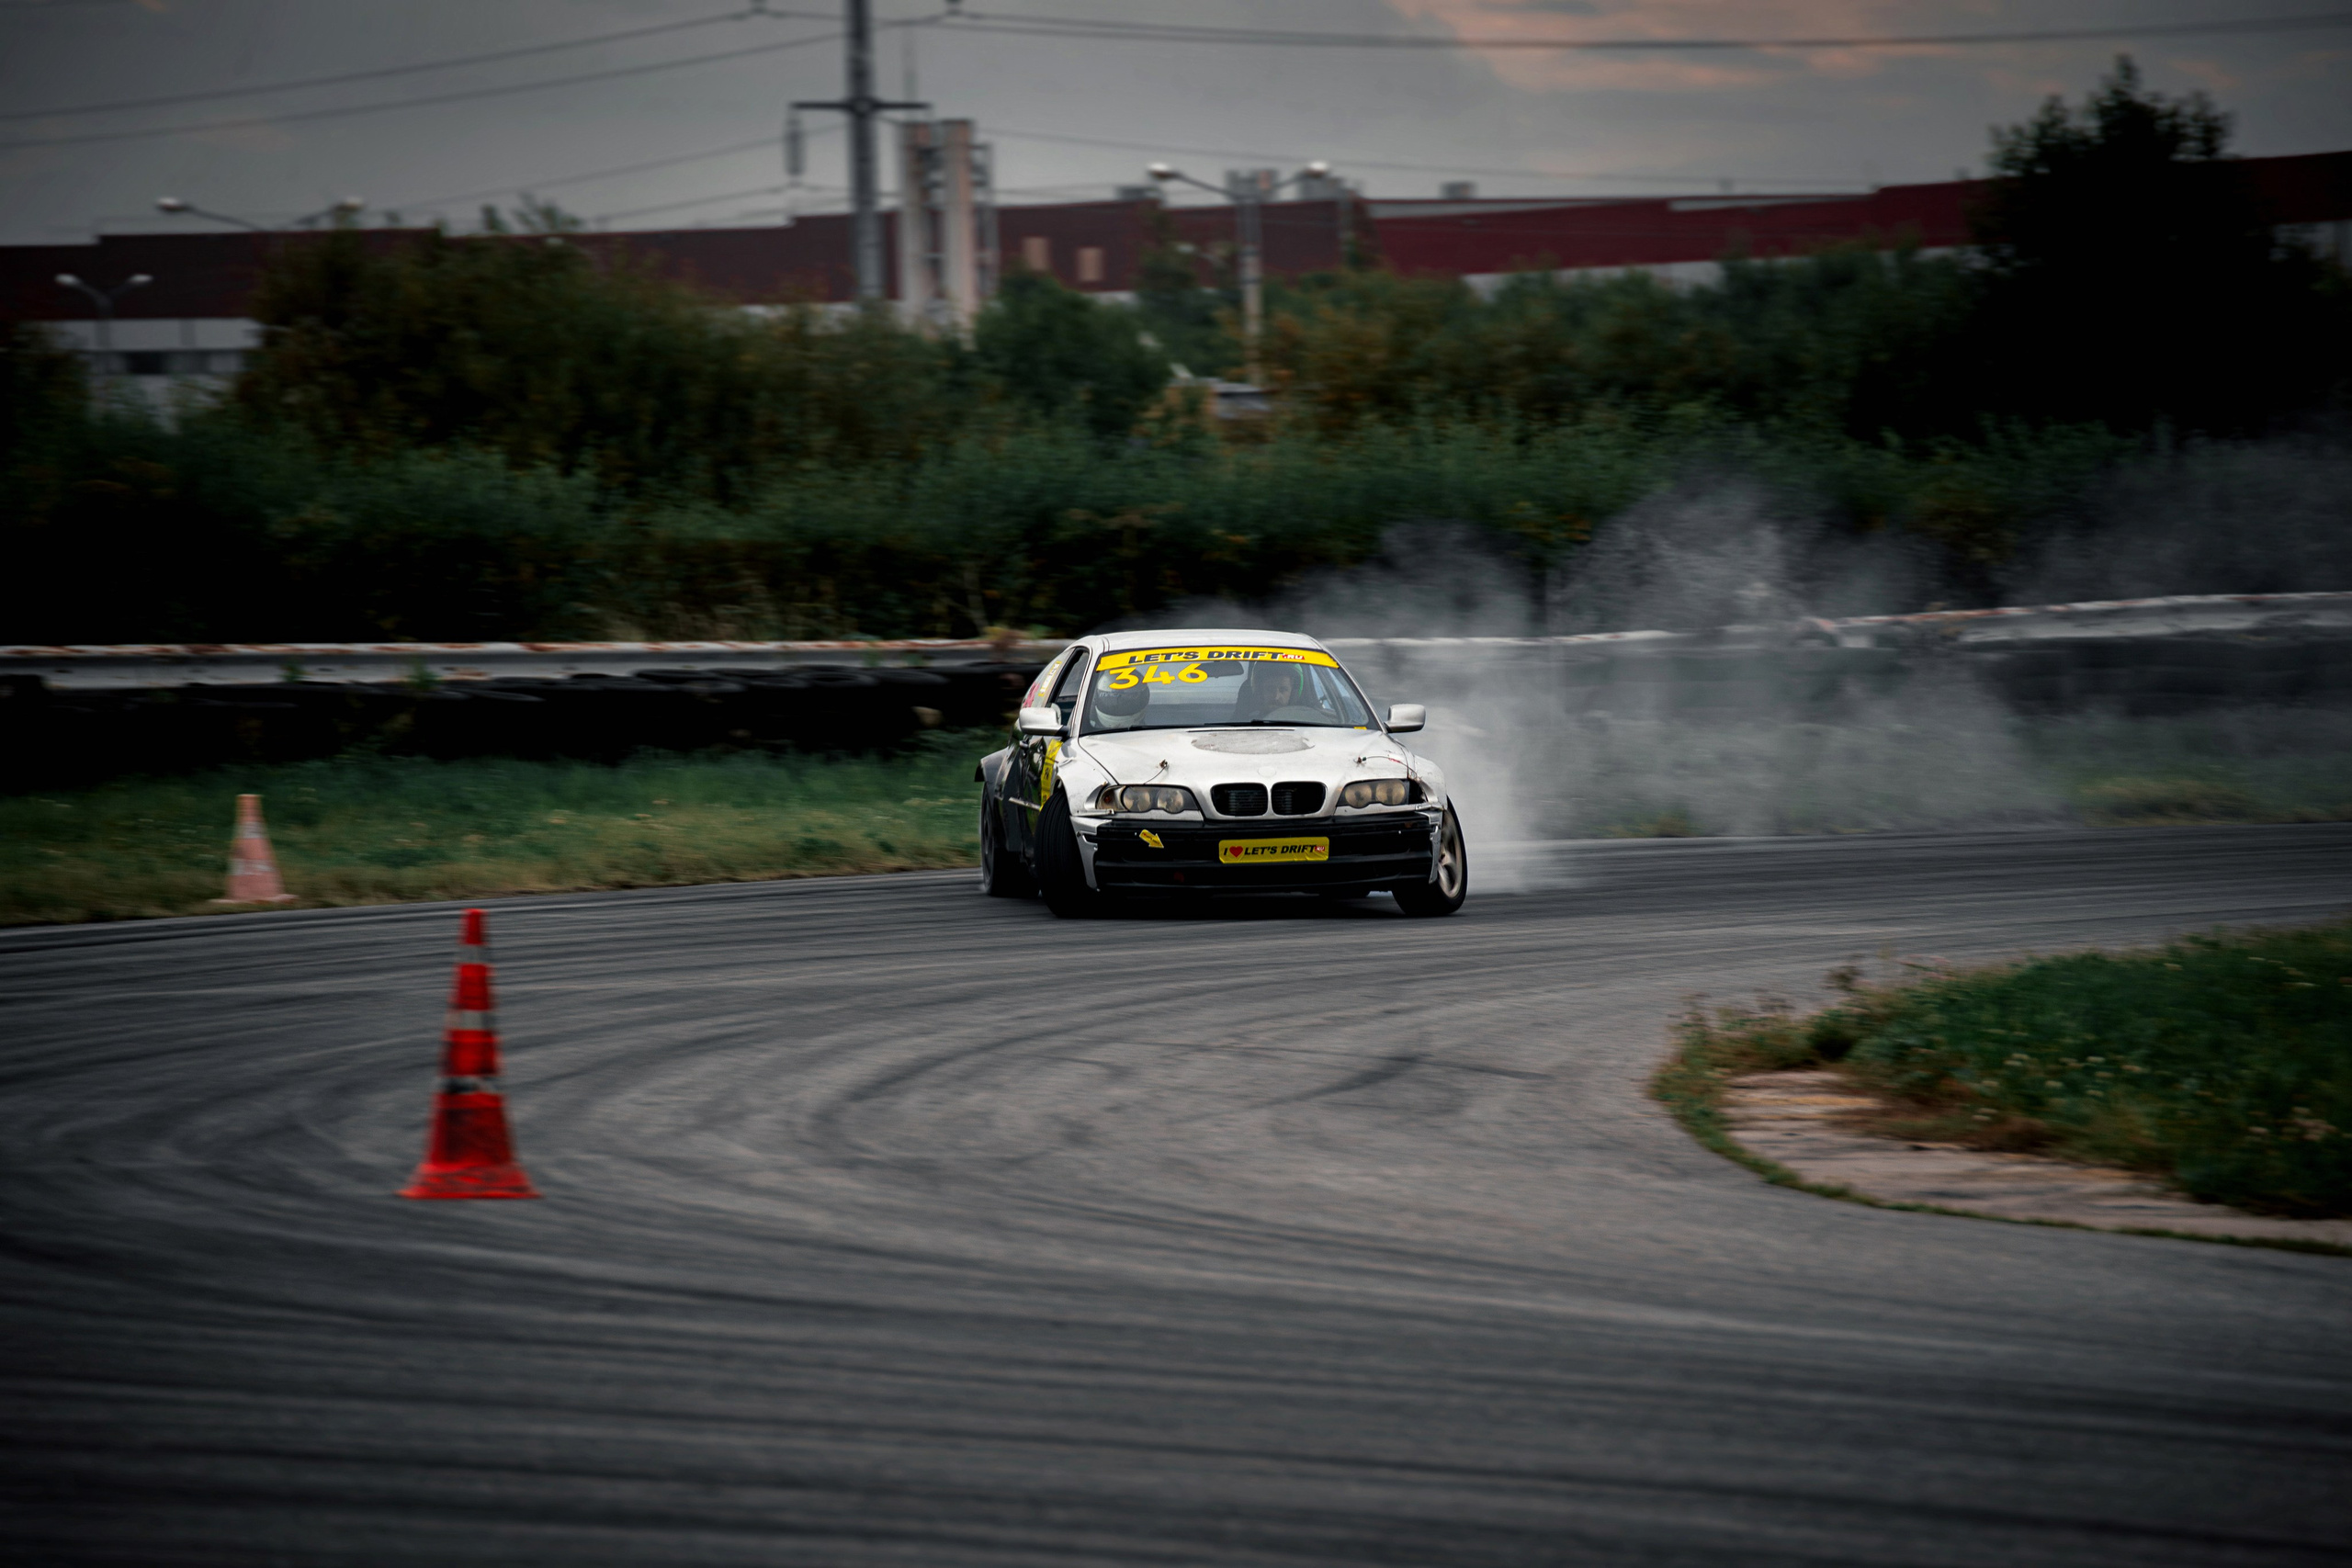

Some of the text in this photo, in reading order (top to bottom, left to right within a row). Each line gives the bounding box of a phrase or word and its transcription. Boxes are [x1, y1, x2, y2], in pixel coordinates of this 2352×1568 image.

[1128, 651, 1199, 664] LET'S
[1108, 663, 1208, 690] 346
[1244, 846, 1277, 855] LET'S
